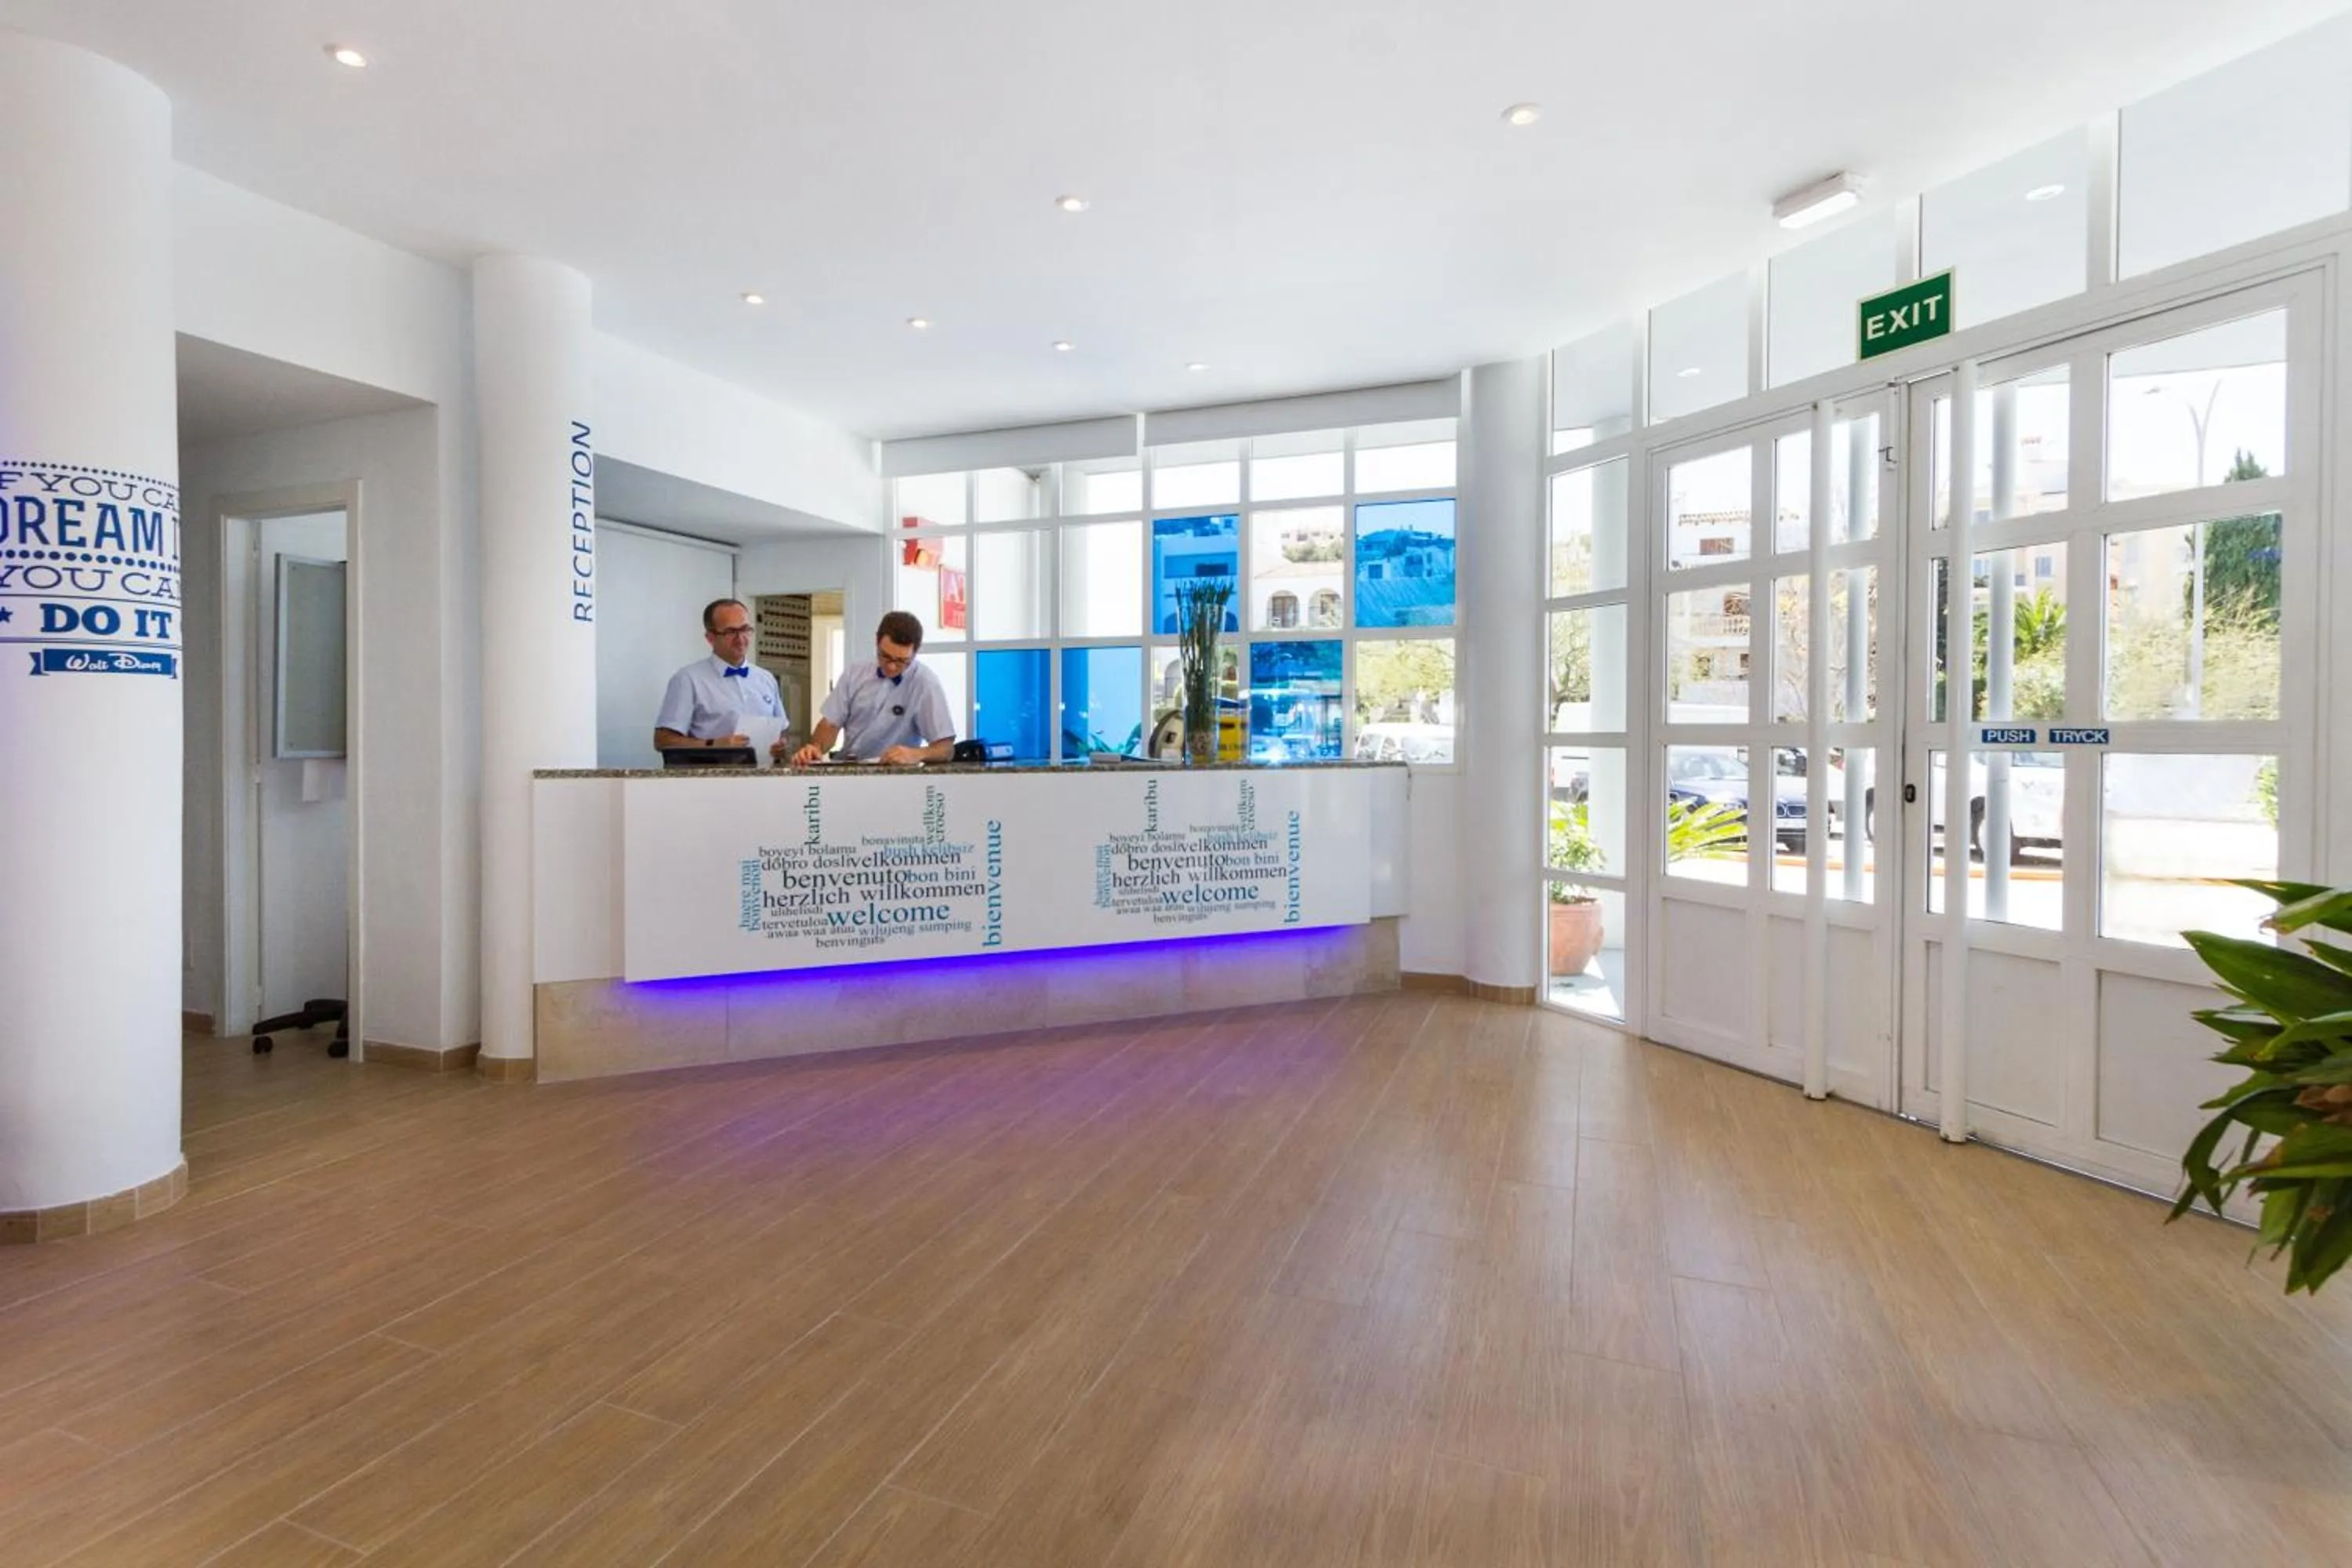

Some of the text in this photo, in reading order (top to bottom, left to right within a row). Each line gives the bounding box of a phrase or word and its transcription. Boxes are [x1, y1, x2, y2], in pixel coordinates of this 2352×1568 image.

[1867, 294, 1943, 340] EXIT
[31, 473, 138, 500] YOU
[143, 488, 180, 512] CA
[0, 495, 163, 557] REAM
[572, 421, 593, 622] RECEPTION
[122, 572, 180, 601] CA
[39, 603, 172, 639] DO IT
[66, 653, 109, 670] Walt
[1987, 730, 2030, 742] PUSH
[2054, 730, 2107, 742] TRYCK
[804, 786, 820, 846] karibu
[923, 785, 935, 845] wellkom
[1145, 779, 1157, 832] karibu
[808, 844, 856, 855] bolamu
[1180, 838, 1268, 852] velkommen
[849, 851, 961, 869] velkommen
[1128, 853, 1226, 871] benvenuto
[1225, 852, 1279, 866] bon bini
[1284, 810, 1301, 923] bienvenue
[783, 869, 908, 889] benvenuto
[906, 866, 976, 883] bon bini
[982, 819, 1002, 946] bienvenue
[1112, 866, 1287, 887] herzlich willkommen
[763, 882, 985, 909] herzlich willkommen
[1163, 884, 1258, 905] welcome
[762, 916, 828, 930] tervetuloa
[826, 902, 950, 927] welcome
[919, 920, 971, 933] sumping
